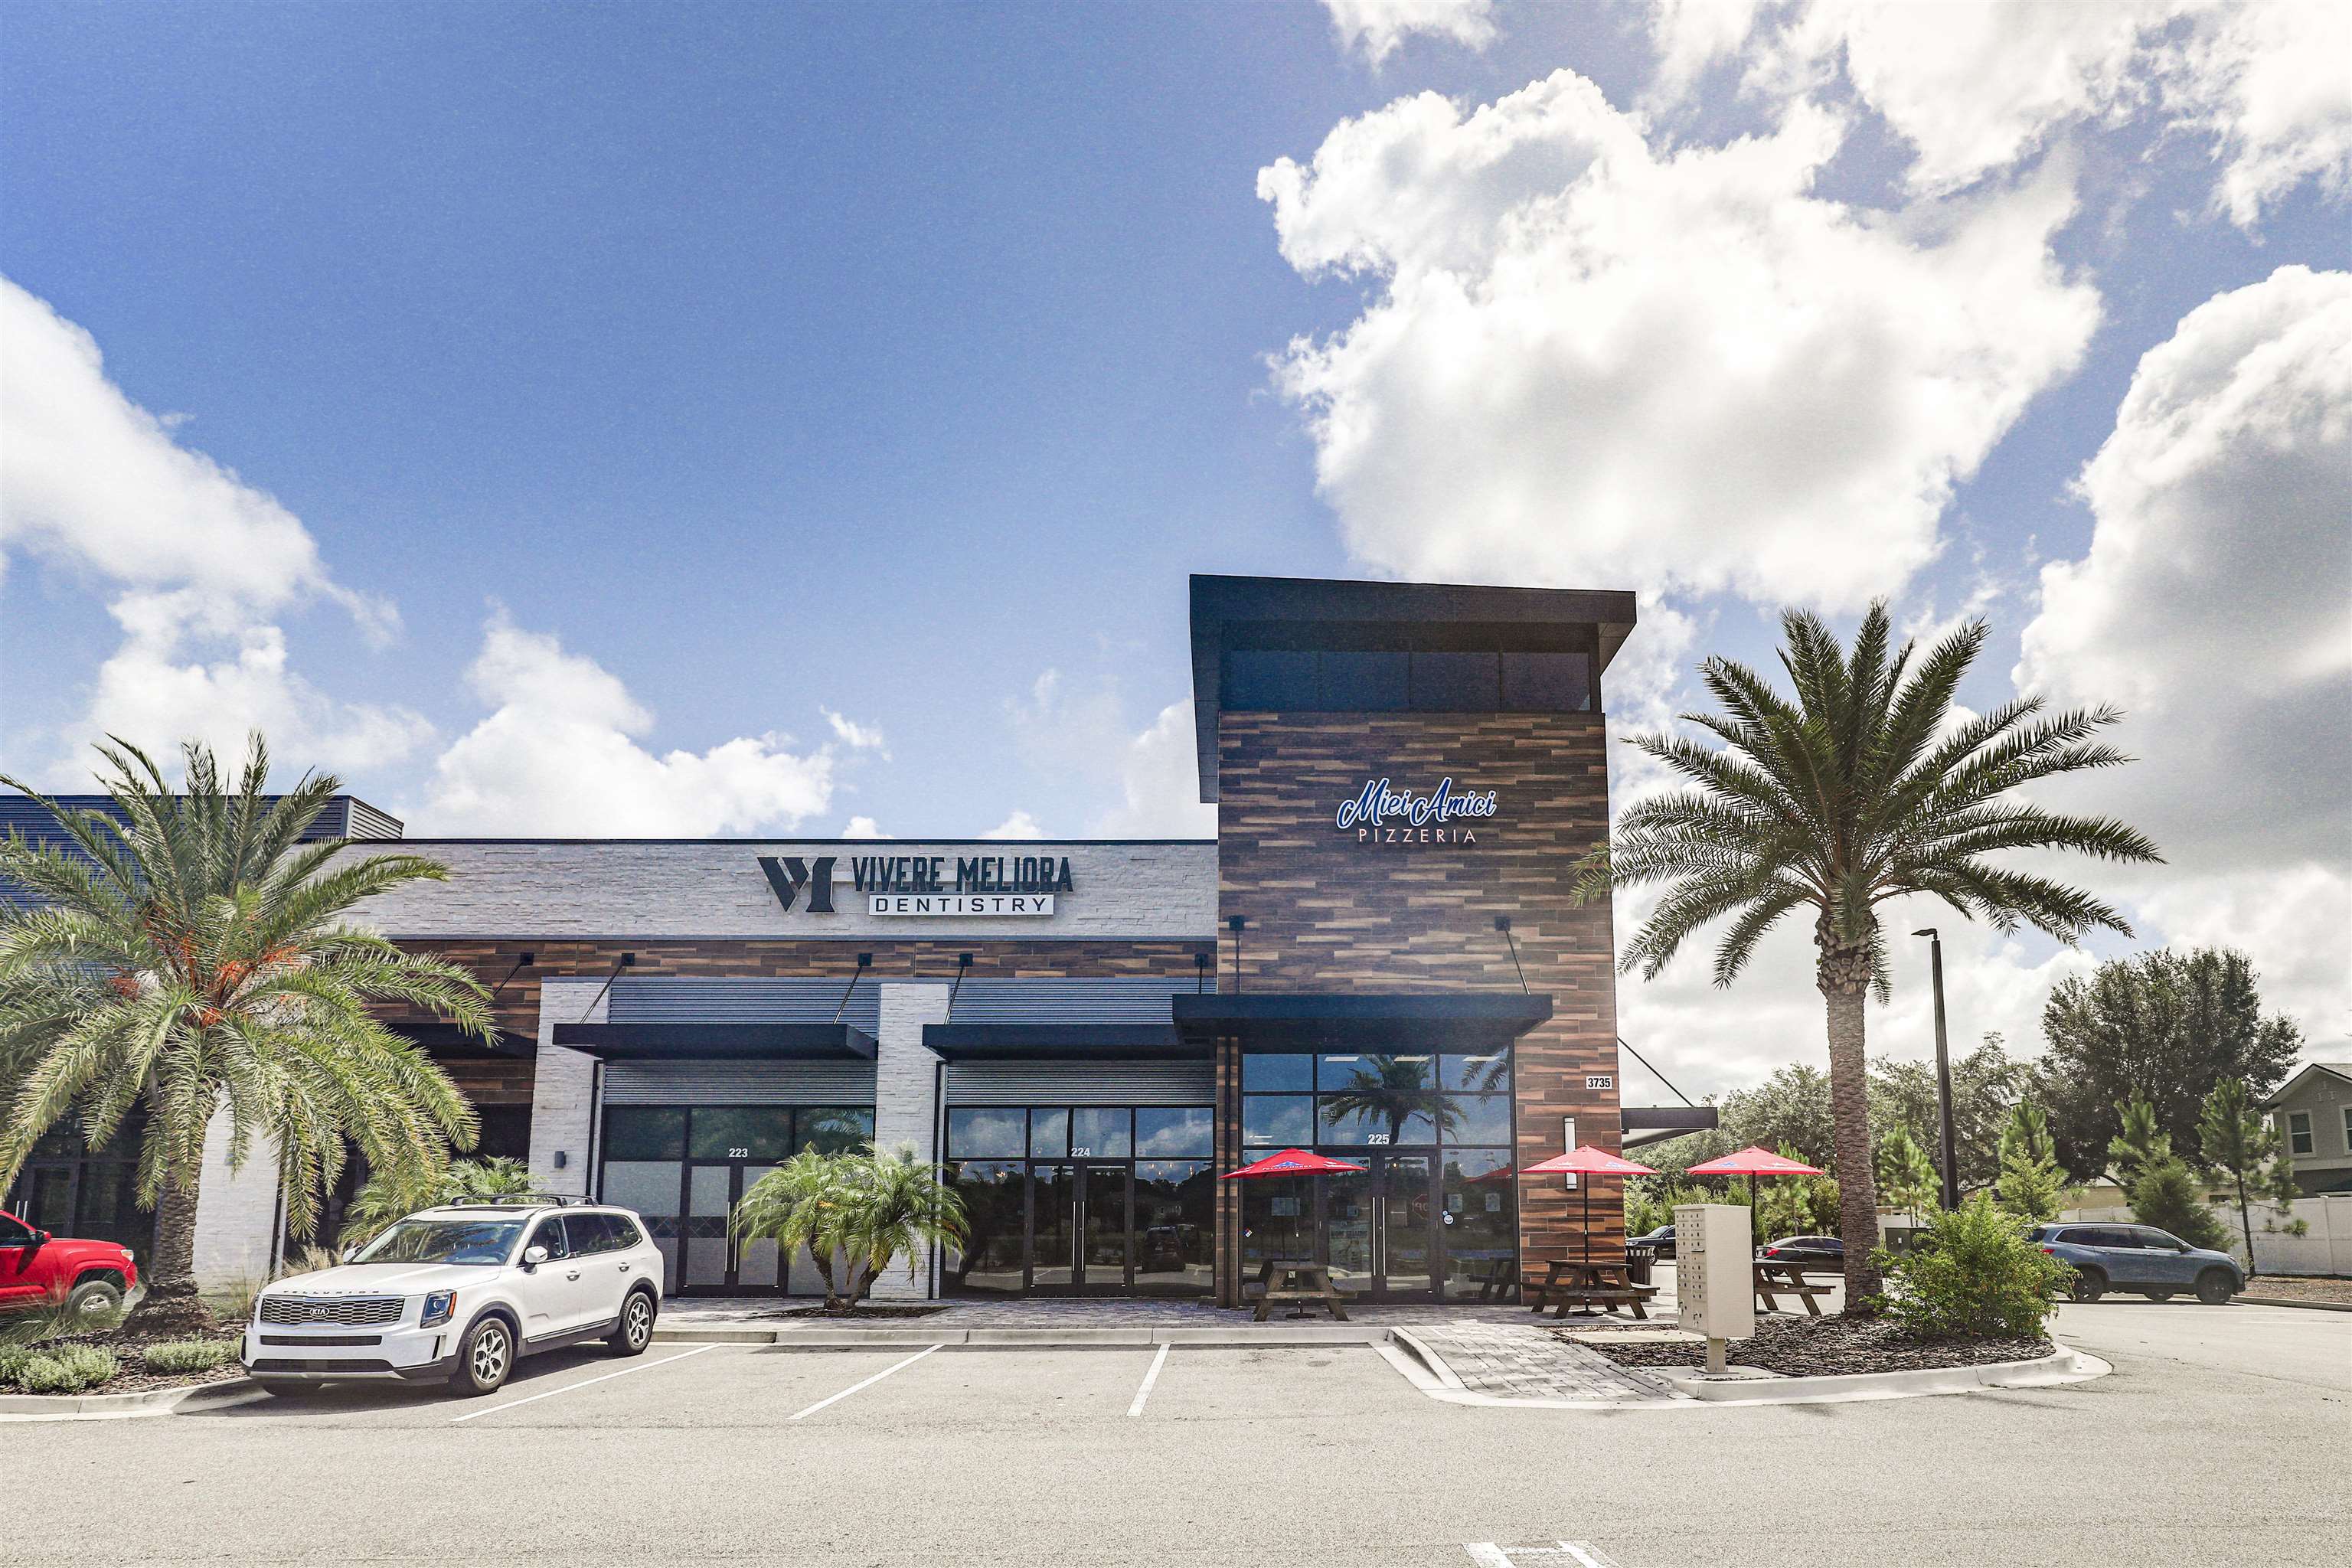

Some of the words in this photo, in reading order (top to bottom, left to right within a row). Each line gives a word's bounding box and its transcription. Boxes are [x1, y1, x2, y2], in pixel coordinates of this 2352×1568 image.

[1337, 777, 1411, 828] Miei
[1409, 776, 1497, 826] Amici
[1358, 828, 1476, 843] PIZZERIA
[851, 857, 945, 892] VIVERE
[956, 857, 1073, 892] MELIORA
[875, 898, 1047, 912] DENTISTRY
[1588, 1077, 1611, 1088] 3735
[1367, 1133, 1390, 1145] 225
[728, 1148, 748, 1158] 223
[1071, 1147, 1091, 1157] 224
